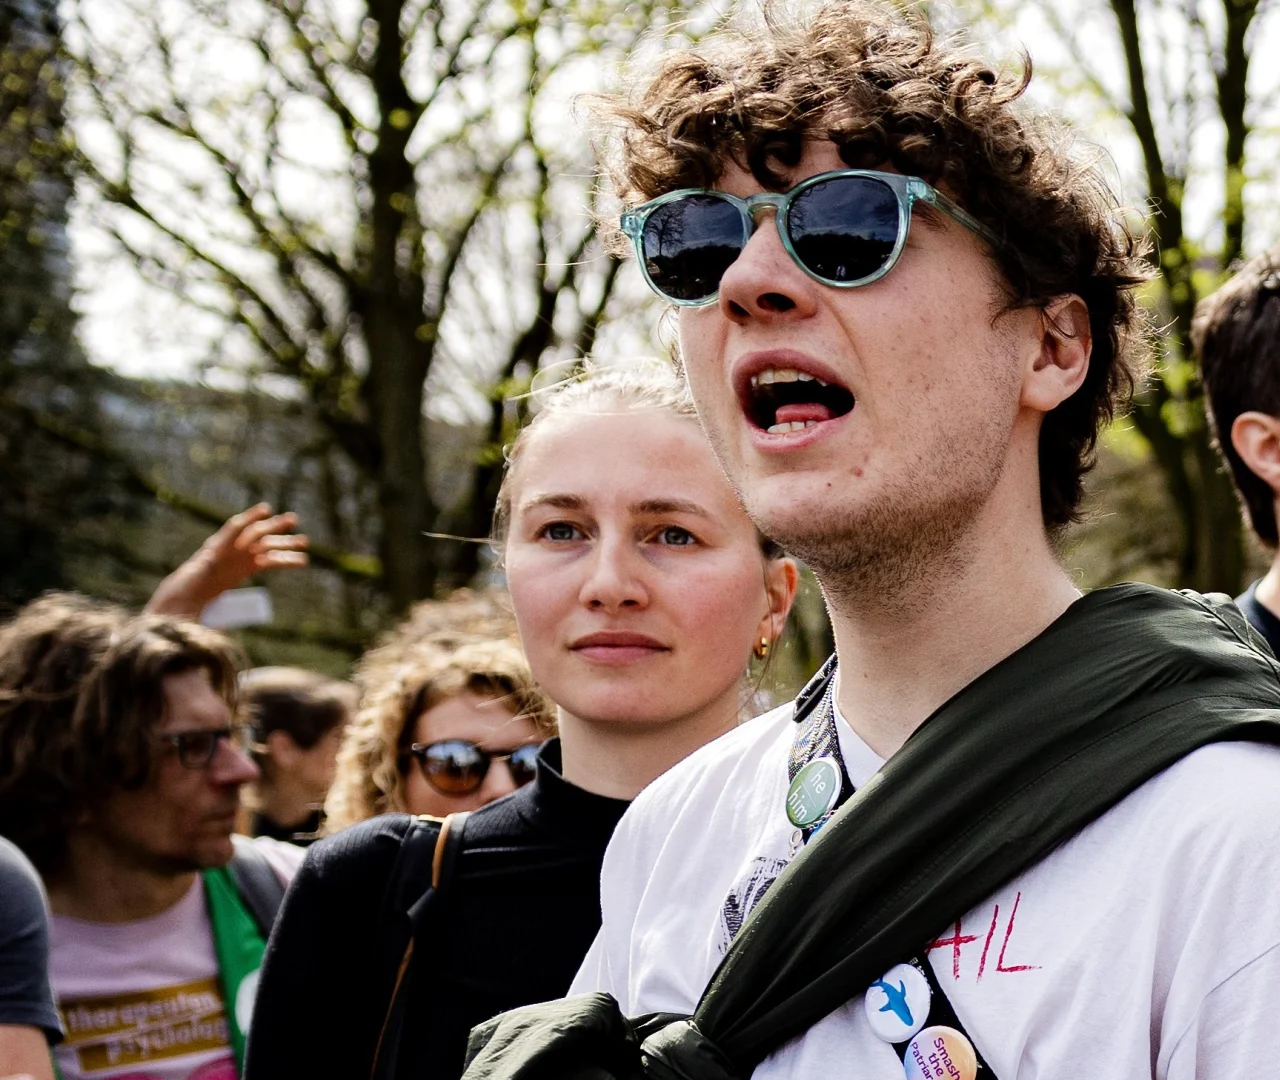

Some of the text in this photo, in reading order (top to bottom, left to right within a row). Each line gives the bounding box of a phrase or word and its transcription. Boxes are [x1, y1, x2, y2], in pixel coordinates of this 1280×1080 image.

[810, 768, 826, 794] he
[788, 786, 808, 822] him
[928, 1052, 945, 1077] the
